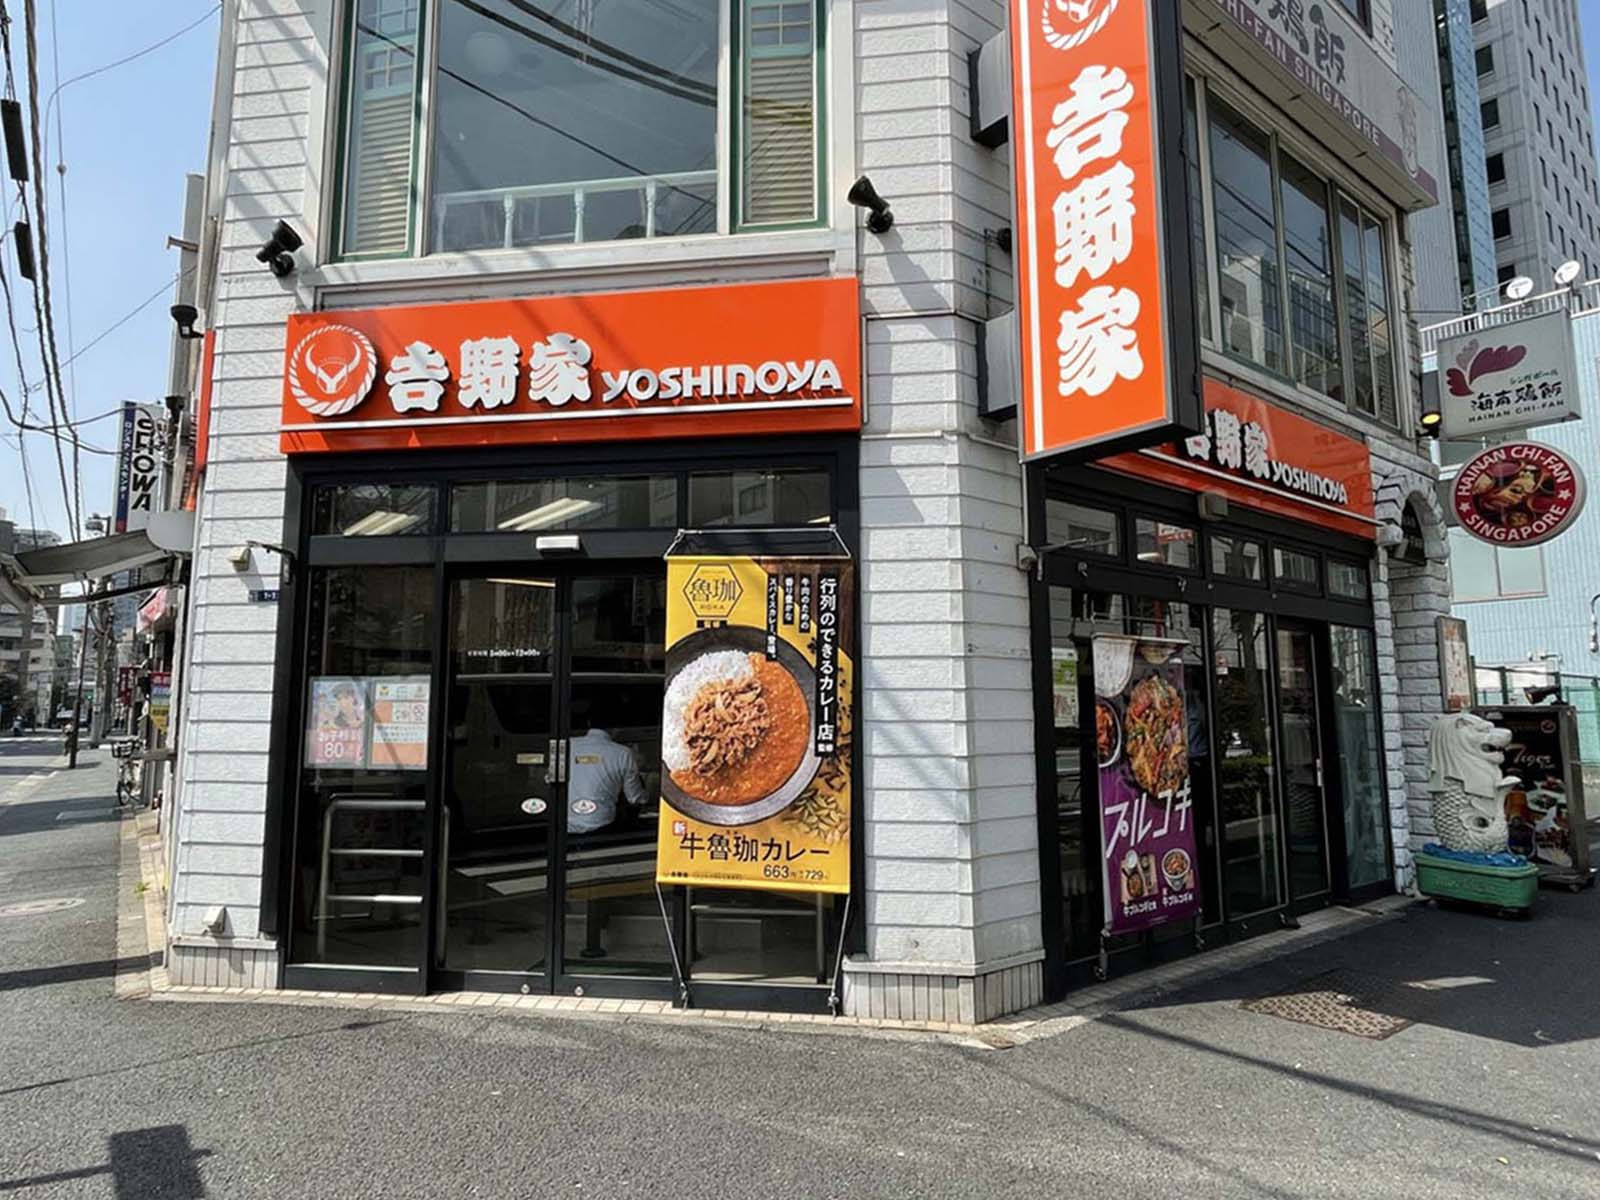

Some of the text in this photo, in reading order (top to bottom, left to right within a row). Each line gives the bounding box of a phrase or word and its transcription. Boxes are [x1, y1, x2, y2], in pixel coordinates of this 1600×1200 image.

[1217, 0, 1381, 147] HI-FAN SINGAPORE
[1046, 65, 1145, 397] 吉野家
[385, 332, 843, 412] 吉野家 YOSHINOYA
[1468, 400, 1564, 423] HAINAN CHI-FAN
[1272, 460, 1348, 504] YOSHINOYA
[1457, 446, 1572, 496] HAINAN CHI-FAN
[1465, 504, 1566, 541] SINGAPORE
[1104, 775, 1192, 859] プルコギ
[680, 832, 830, 862] 牛魯珈カレー
